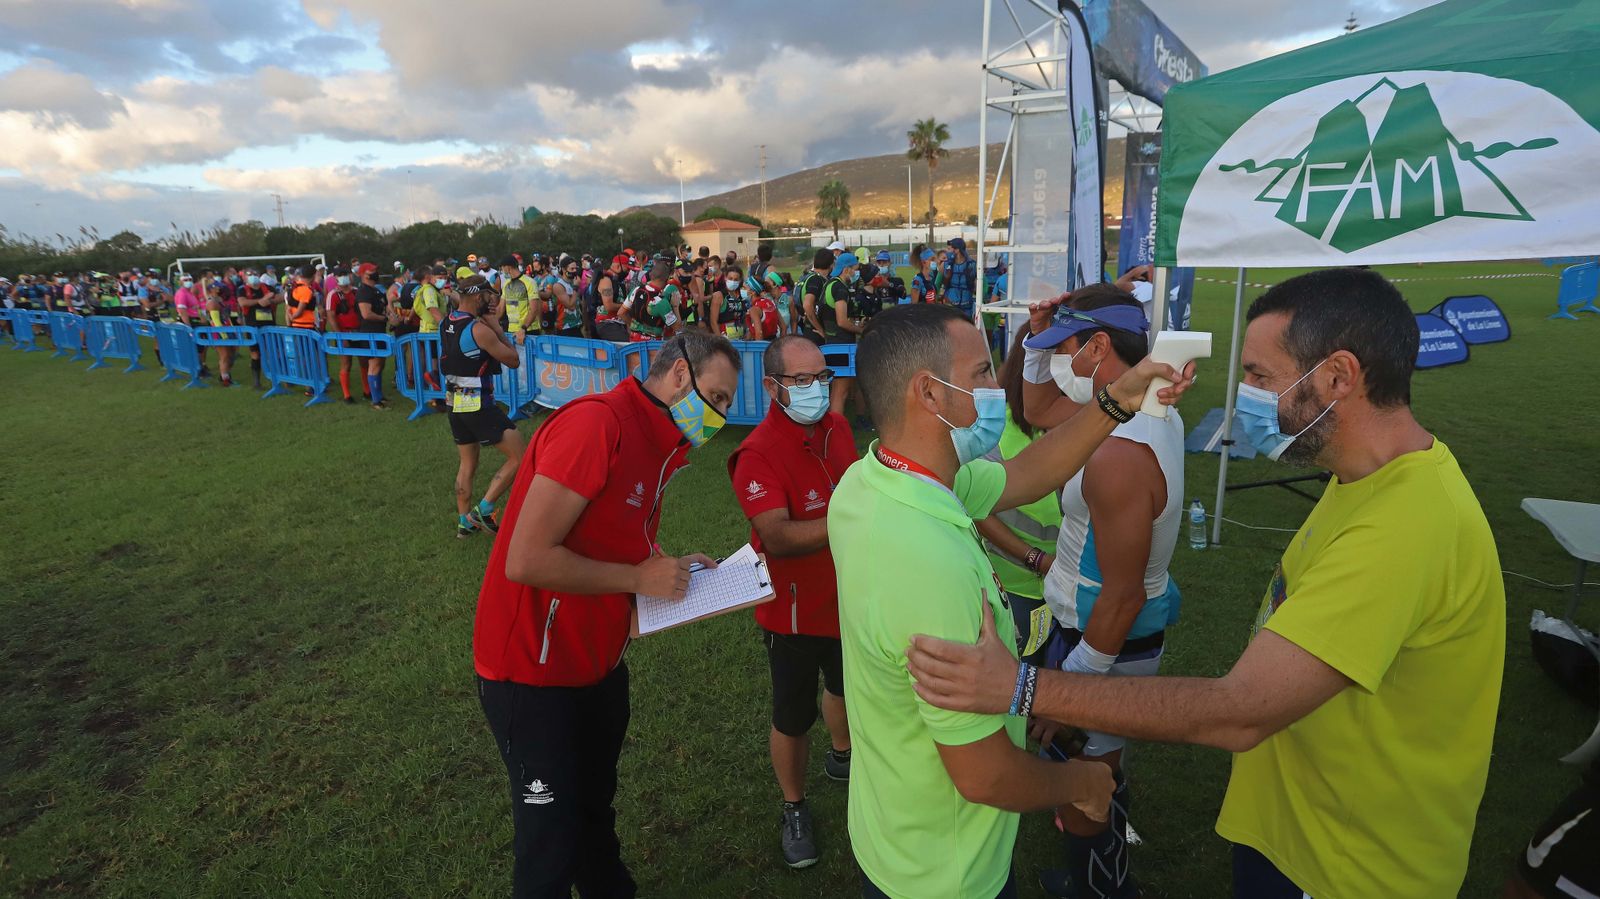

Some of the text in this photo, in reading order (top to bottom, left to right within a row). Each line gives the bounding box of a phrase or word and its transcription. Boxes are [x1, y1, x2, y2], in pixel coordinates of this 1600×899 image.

[1295, 149, 1445, 246] FAM
[1137, 236, 1148, 262] sierra
[1457, 309, 1501, 322] Ayuntamiento
[1467, 319, 1502, 331] de La Línea
[1419, 328, 1456, 340] tamiento
[1426, 341, 1437, 352] La
[1435, 339, 1459, 351] Línea
[877, 448, 909, 471] bonera
